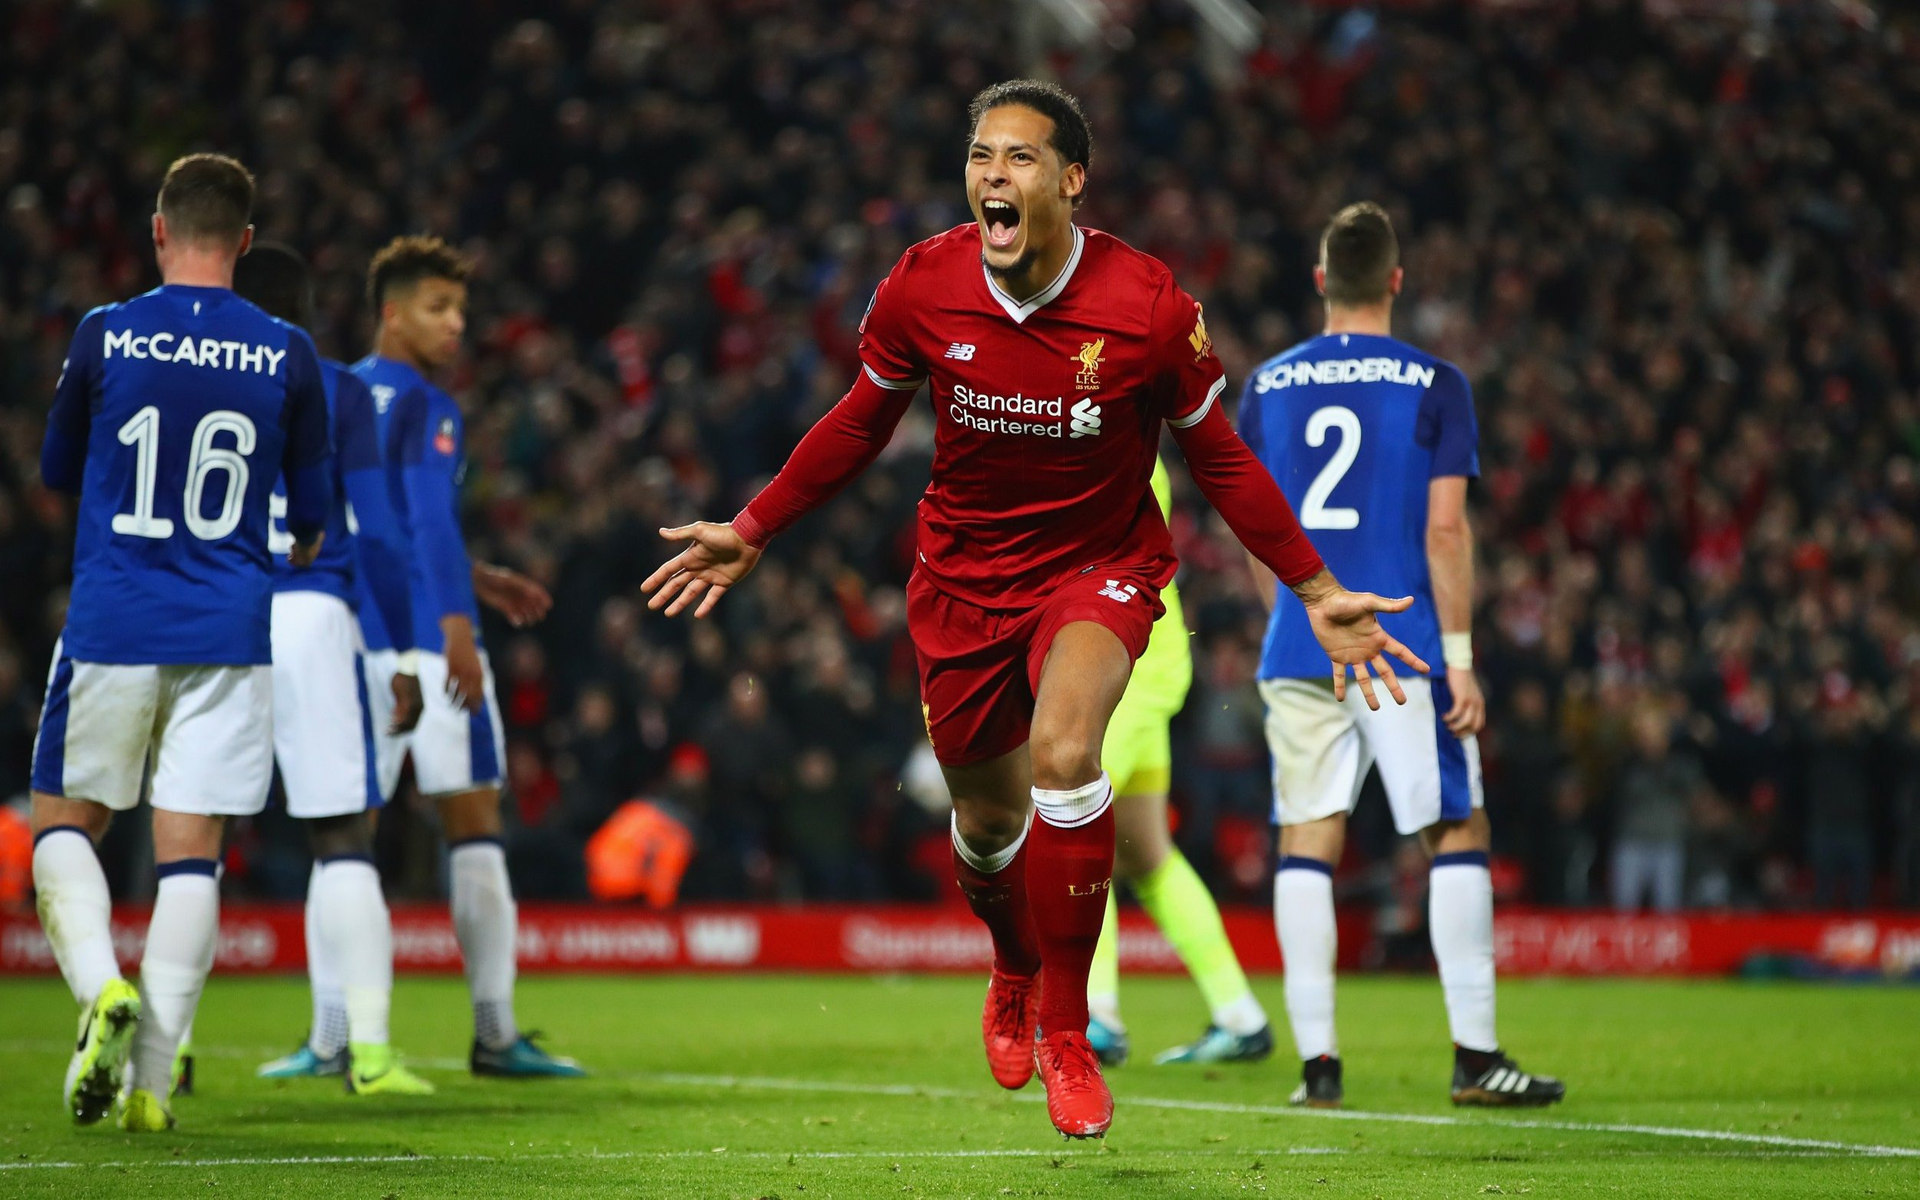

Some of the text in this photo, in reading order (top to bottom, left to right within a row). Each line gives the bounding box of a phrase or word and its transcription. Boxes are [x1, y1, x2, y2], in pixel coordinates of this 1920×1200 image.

[103, 328, 286, 376] McCARTHY
[1255, 357, 1435, 394] SCHNEIDERLIN
[949, 403, 1062, 438] Chartered
[953, 384, 1062, 417] Standard
[111, 405, 256, 540] 16
[1300, 405, 1362, 530] 2
